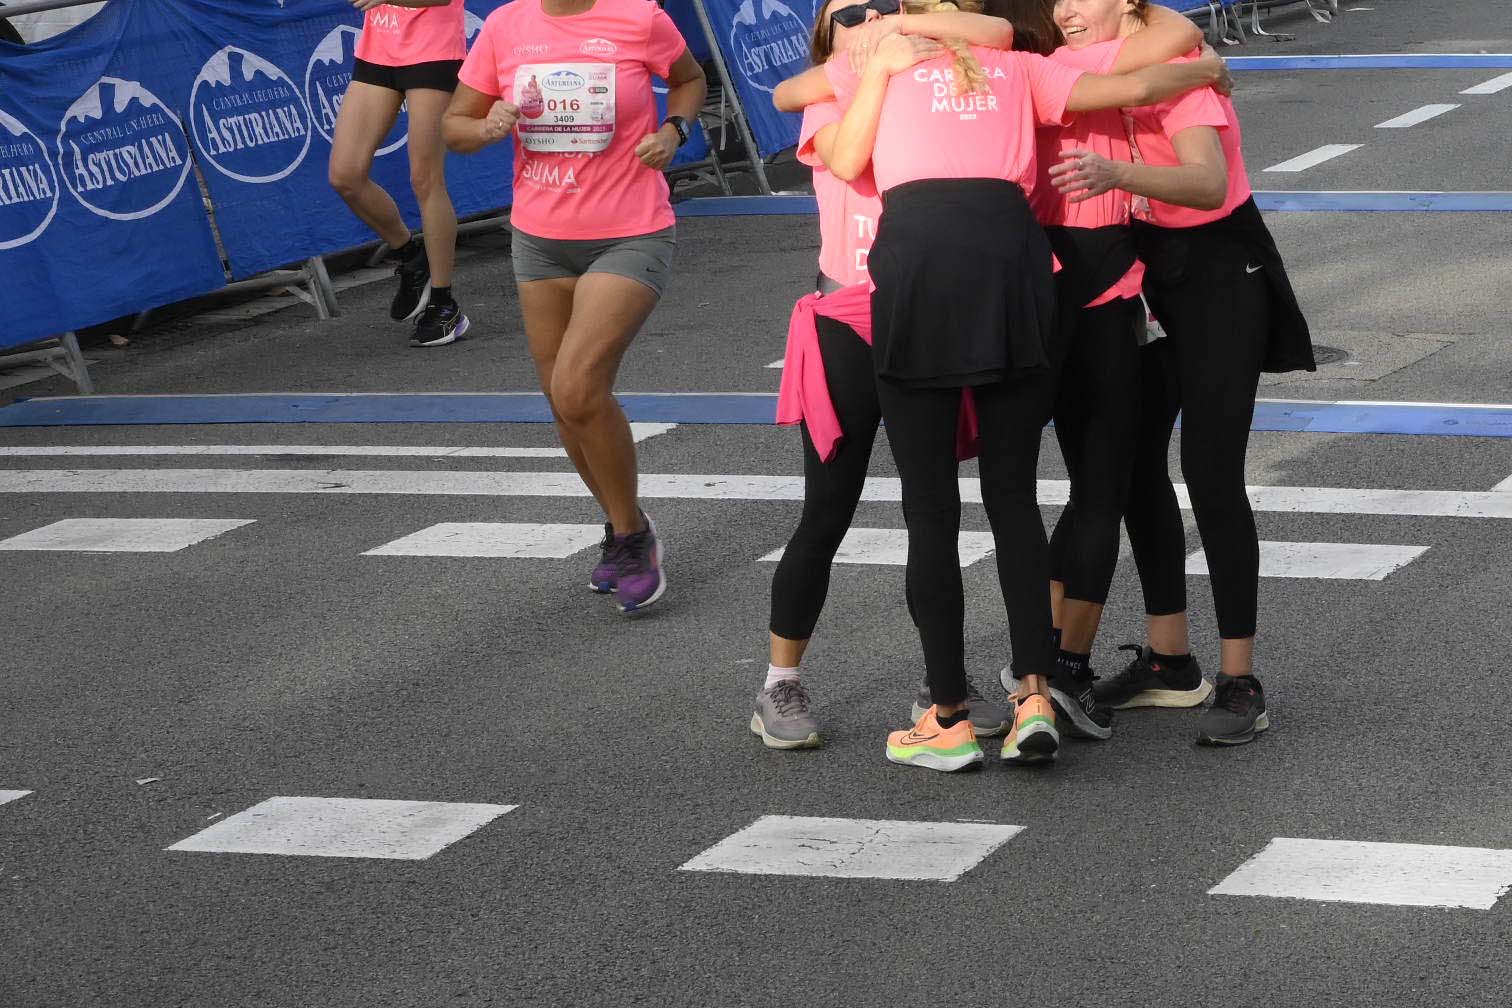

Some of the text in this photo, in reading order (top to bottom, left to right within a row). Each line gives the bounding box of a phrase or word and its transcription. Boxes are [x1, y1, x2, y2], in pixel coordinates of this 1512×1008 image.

[547, 98, 580, 111] 016
[931, 95, 998, 113] MUJER
[554, 115, 575, 123] 3409
[202, 103, 306, 156] ASTURIANA
